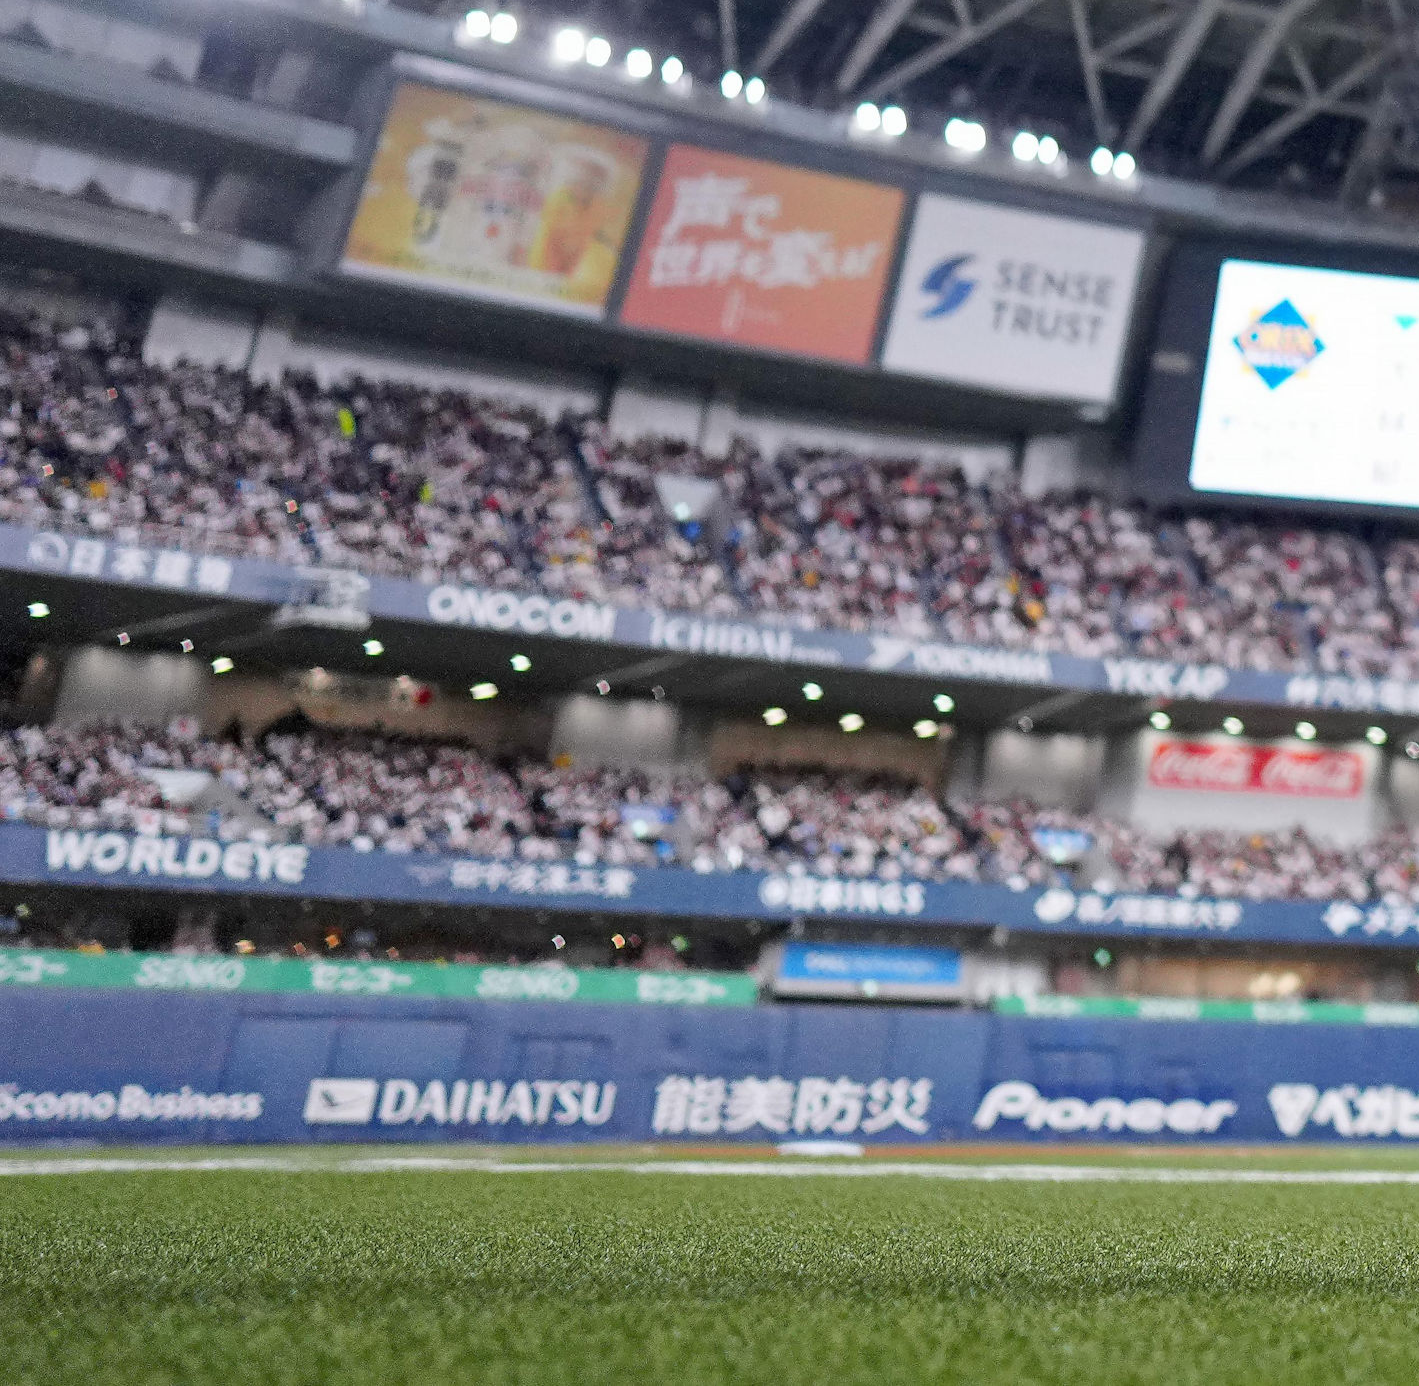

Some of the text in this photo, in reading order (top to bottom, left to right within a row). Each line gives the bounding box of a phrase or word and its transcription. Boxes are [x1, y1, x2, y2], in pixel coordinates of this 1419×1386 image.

[993, 258, 1118, 310] SENSE
[988, 303, 1106, 346] TRUST
[427, 584, 616, 640] ONOCOM
[134, 956, 245, 989] SENKO
[118, 1084, 264, 1121] Business
[379, 1079, 618, 1126] DAIHATSU
[651, 1075, 933, 1134] 能美防災
[974, 1081, 1237, 1133] Pioneer
